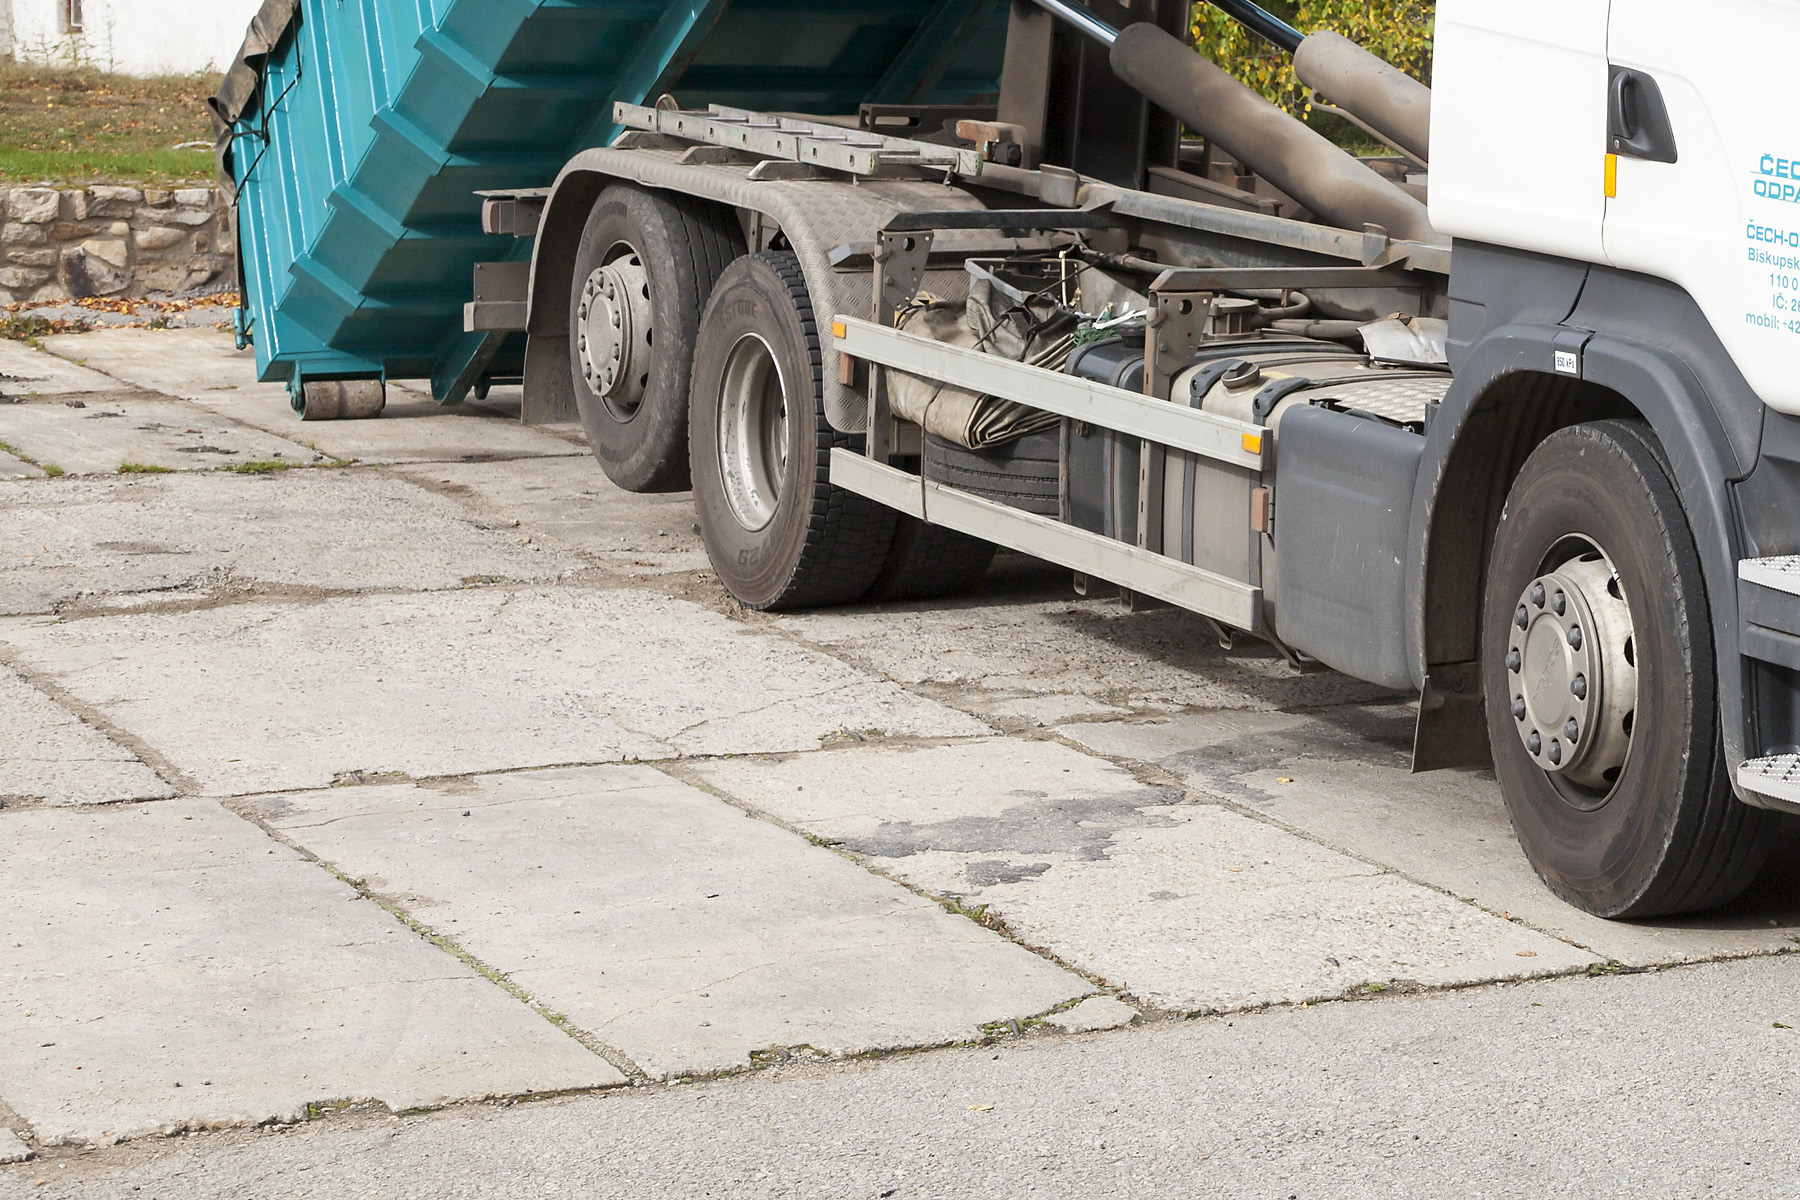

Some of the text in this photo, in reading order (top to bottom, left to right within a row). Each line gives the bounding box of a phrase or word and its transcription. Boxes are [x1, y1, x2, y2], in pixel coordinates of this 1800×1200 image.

[1769, 273, 1789, 289] 110
[1772, 292, 1788, 311] IČ:
[1745, 312, 1780, 330] mobil:
